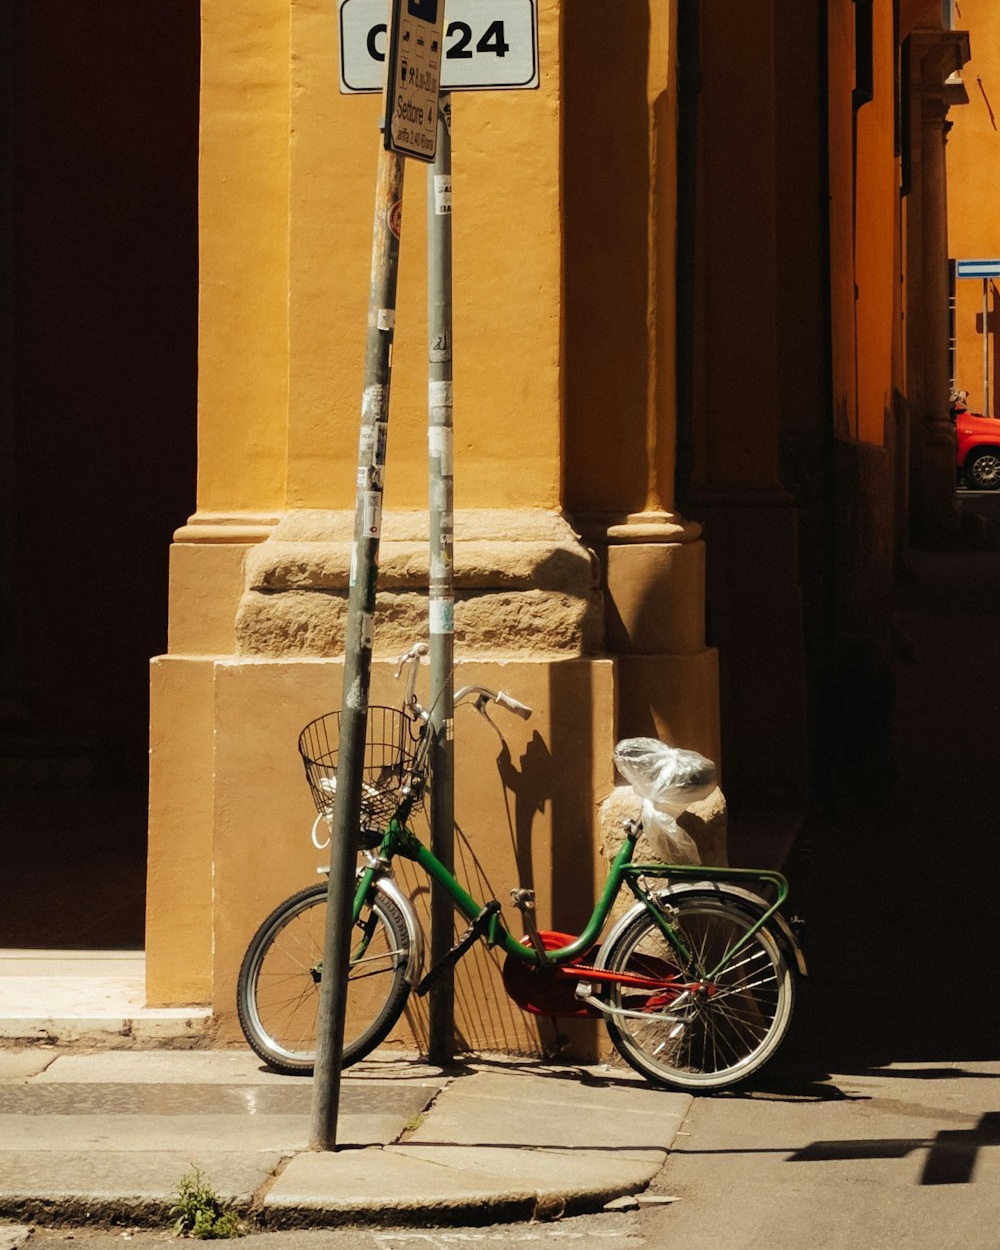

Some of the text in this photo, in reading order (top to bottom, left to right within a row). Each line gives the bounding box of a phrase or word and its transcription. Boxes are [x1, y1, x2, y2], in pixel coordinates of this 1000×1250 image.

[446, 20, 510, 60] 24
[396, 94, 424, 126] Settore
[427, 106, 433, 125] 4
